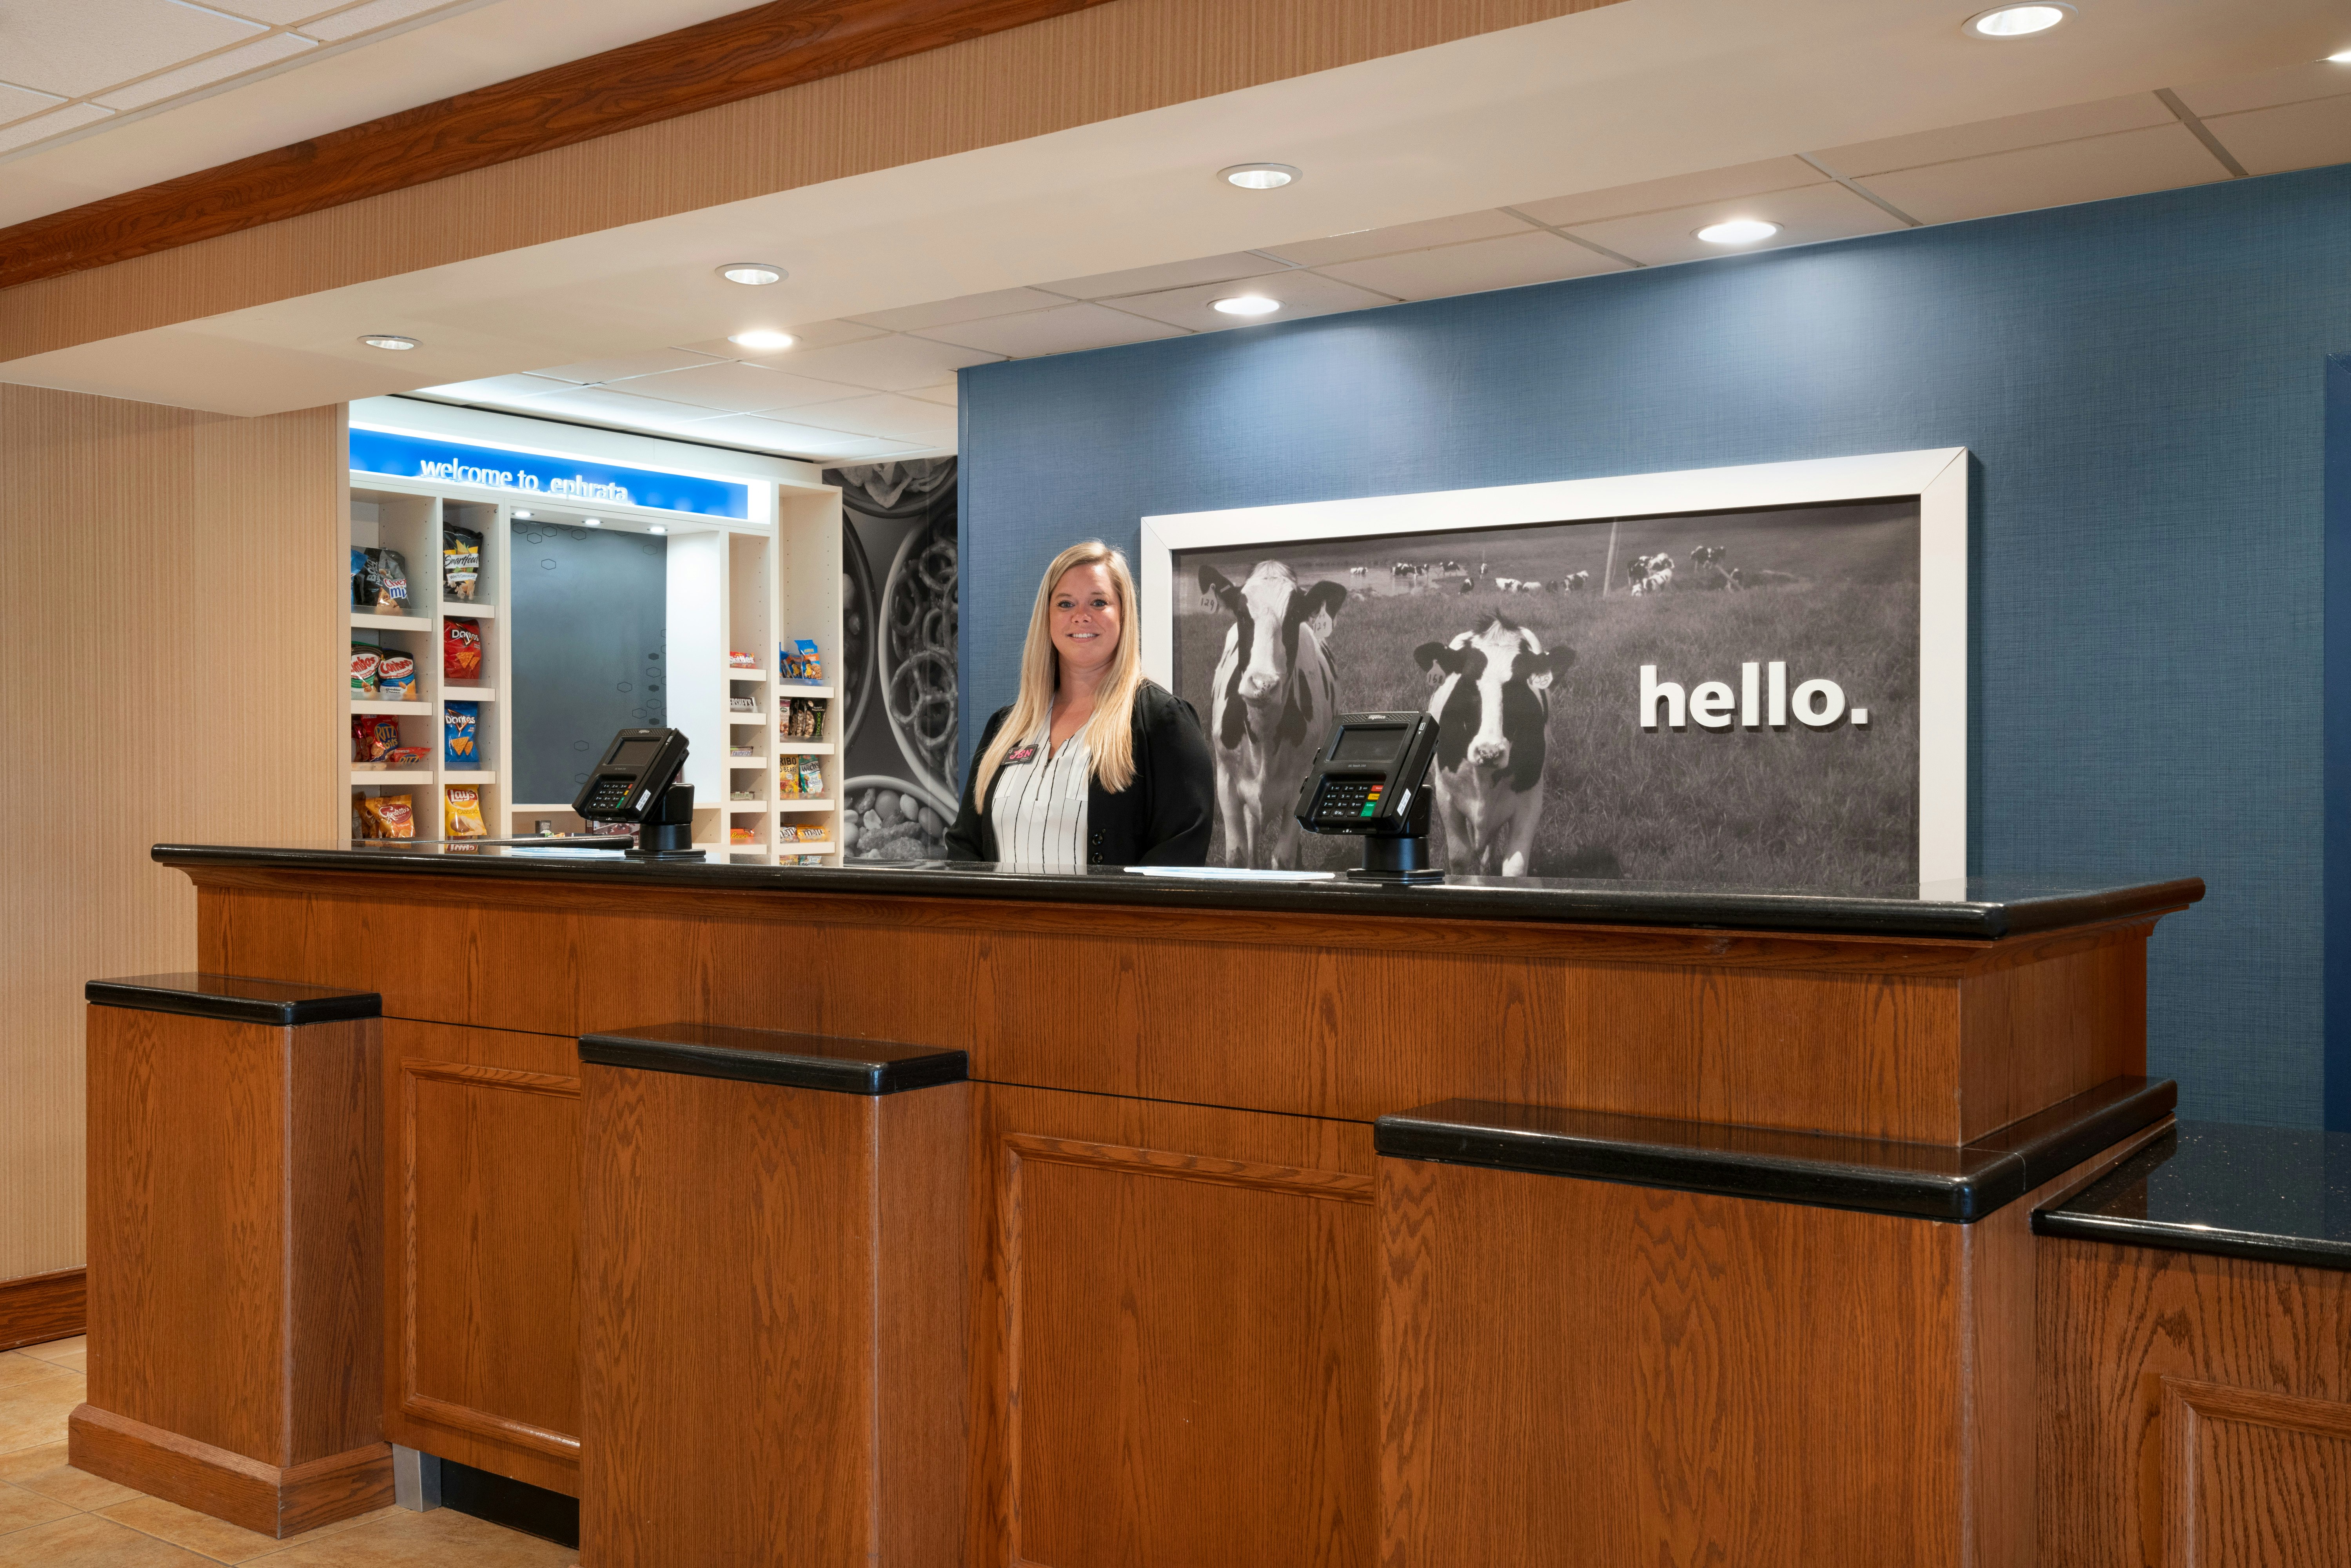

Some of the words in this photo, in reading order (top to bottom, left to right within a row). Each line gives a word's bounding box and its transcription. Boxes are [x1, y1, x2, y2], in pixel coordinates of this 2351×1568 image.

[420, 458, 513, 486] welcome
[517, 470, 539, 490] to
[550, 475, 628, 502] ephrata
[444, 554, 479, 567] Smartfood
[384, 578, 407, 587] Chex
[390, 587, 407, 598] mi
[452, 629, 479, 642] Doritos
[351, 657, 376, 673] mbos
[729, 655, 754, 664] Skittles
[380, 660, 412, 674] Combos
[1640, 661, 1868, 728] hello.
[730, 698, 752, 706] ERSHEY'S
[445, 715, 476, 724] Doritos
[374, 726, 396, 741] RITZ
[383, 738, 398, 750] bits
[1009, 748, 1033, 759] JEN
[780, 757, 797, 766] RIBO
[450, 789, 475, 802] Lay's
[379, 806, 410, 824] Gardetto's
